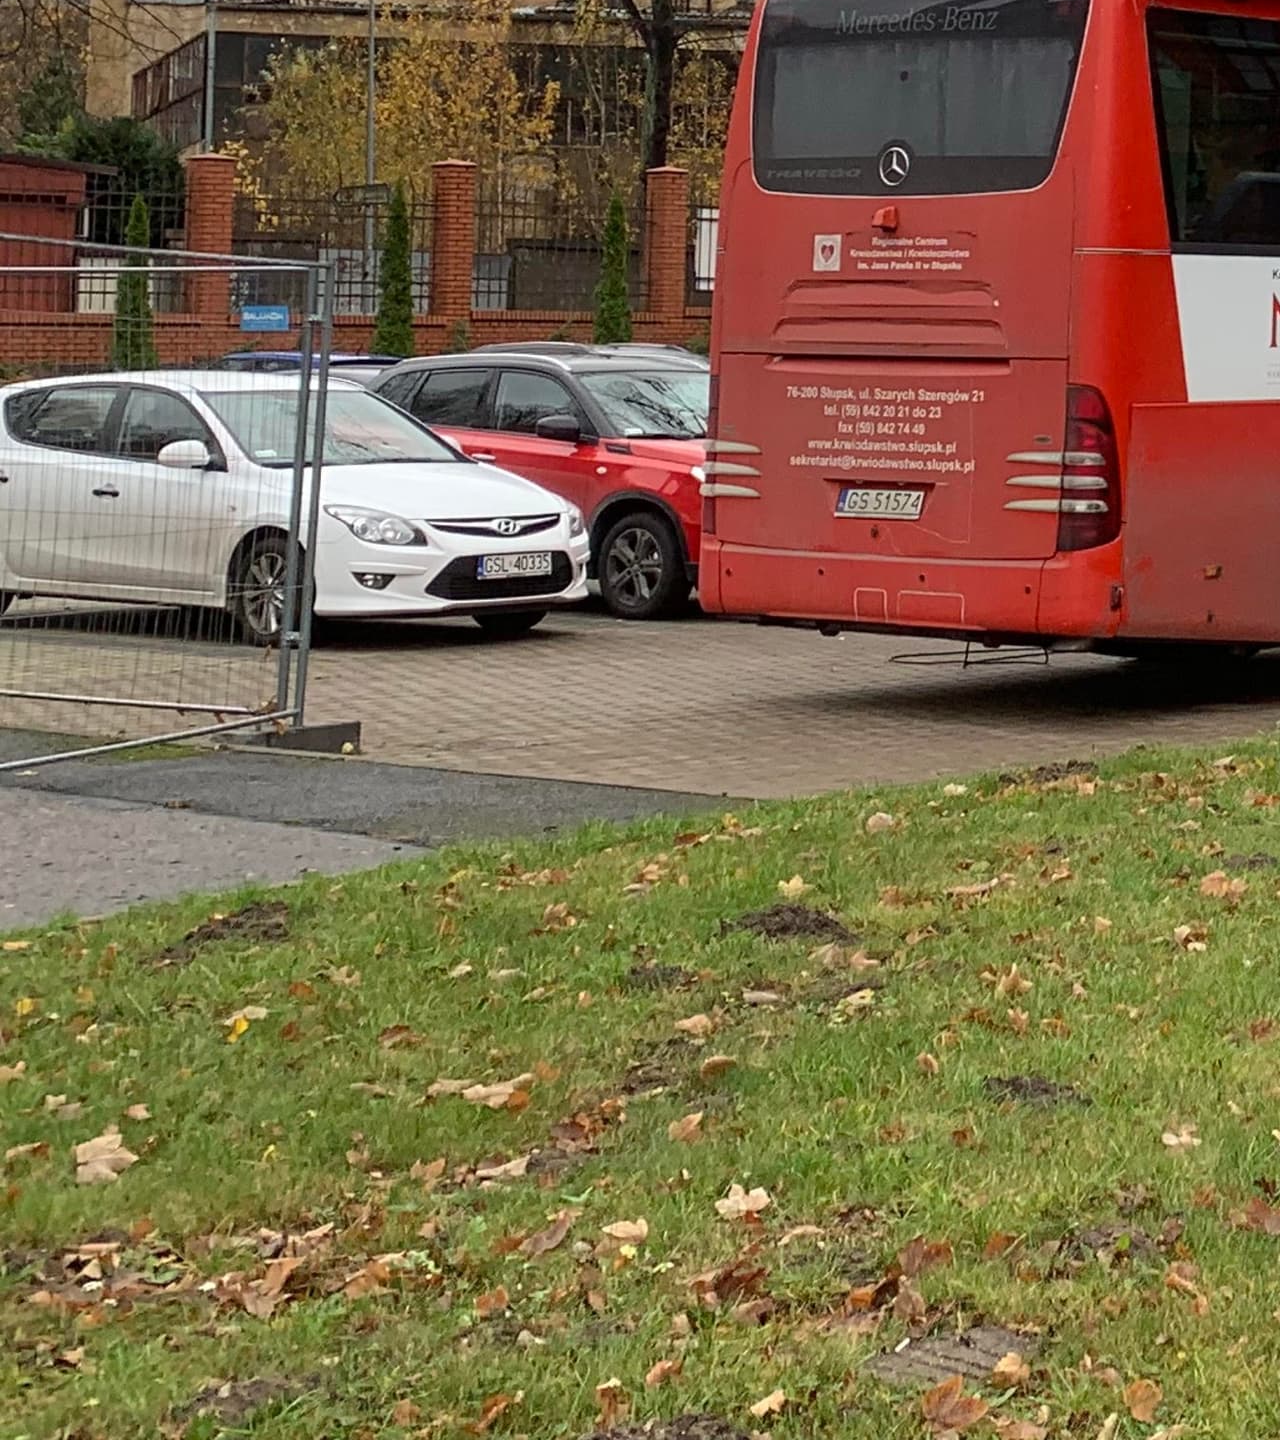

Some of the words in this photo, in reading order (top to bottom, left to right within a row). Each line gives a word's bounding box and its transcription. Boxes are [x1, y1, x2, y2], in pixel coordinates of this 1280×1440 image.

[835, 6, 1000, 35] Mercedes-Benz
[786, 386, 818, 399] 76-200
[859, 387, 872, 400] ul.
[874, 388, 915, 403] Szarych
[918, 388, 970, 404] Szeregów
[971, 390, 985, 402] 21
[824, 404, 840, 416] tel.
[862, 404, 881, 417] 842
[882, 405, 896, 418] 20
[897, 405, 911, 418] 21
[912, 406, 927, 419] do
[928, 406, 942, 419] 23
[838, 421, 853, 434] fax
[876, 422, 896, 435] 842
[897, 423, 911, 435] 74
[912, 423, 926, 436] 49
[847, 490, 871, 511] GS
[872, 491, 922, 513] 51574
[484, 556, 509, 574] GSL
[513, 552, 550, 571] 40335
